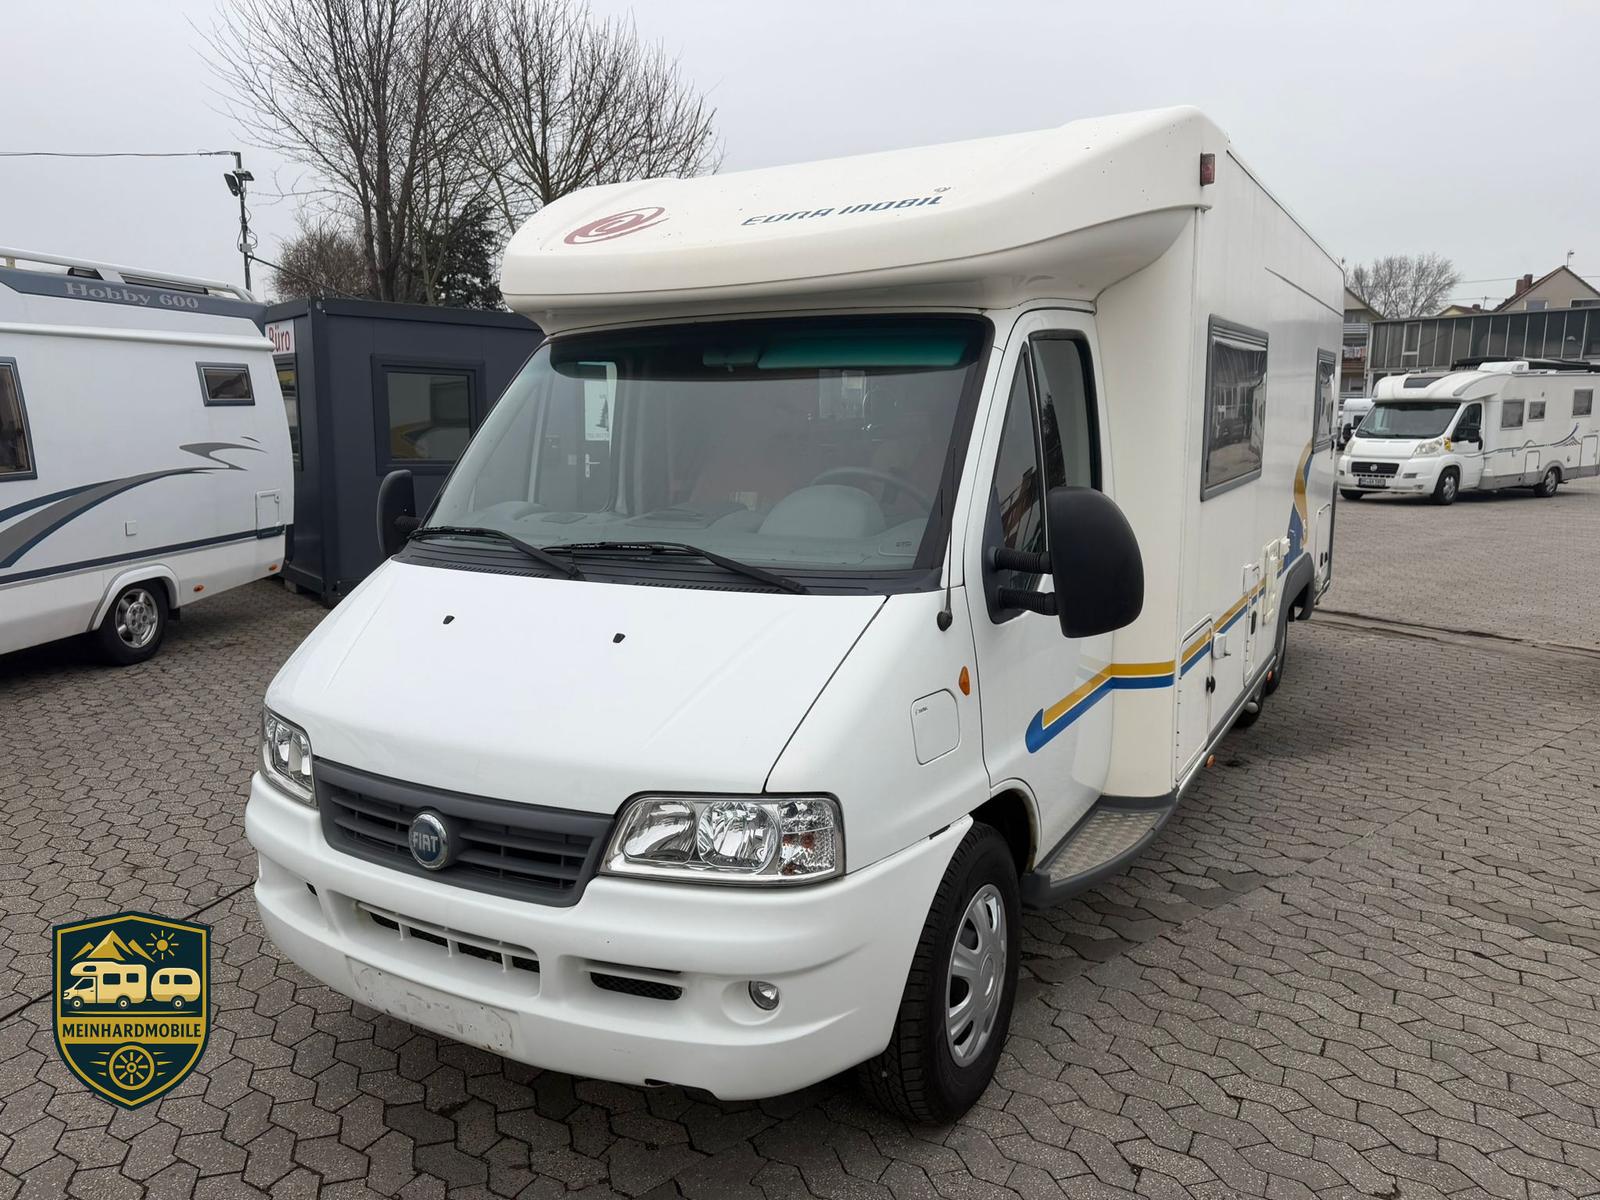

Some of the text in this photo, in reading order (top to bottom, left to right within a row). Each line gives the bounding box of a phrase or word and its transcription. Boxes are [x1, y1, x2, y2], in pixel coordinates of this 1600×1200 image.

[65, 281, 199, 309] Hobby 600
[412, 831, 438, 853] FIAT
